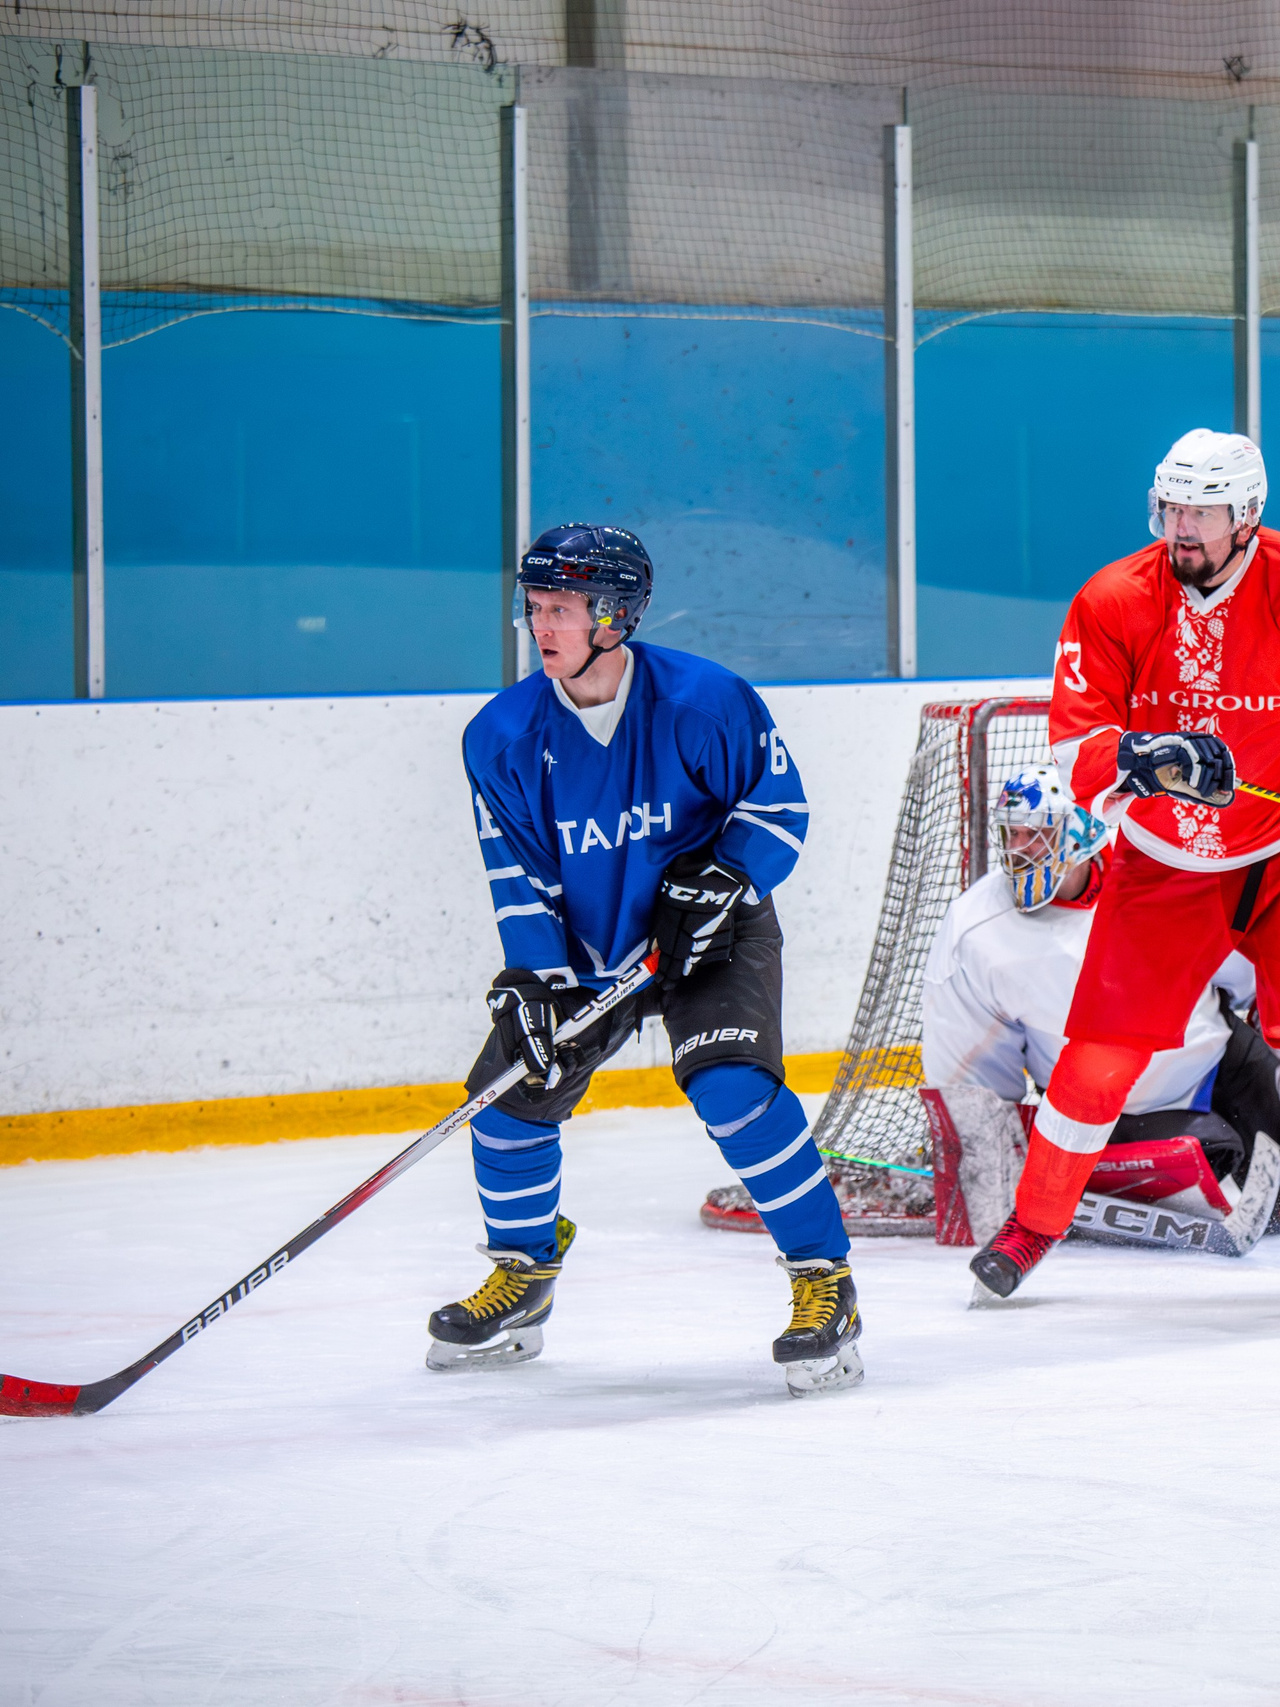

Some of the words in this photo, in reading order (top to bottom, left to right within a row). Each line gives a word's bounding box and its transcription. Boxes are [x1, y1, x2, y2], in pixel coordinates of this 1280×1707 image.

[1168, 476, 1193, 485] CCM
[527, 556, 553, 566] CCM
[619, 573, 638, 581] CCM
[759, 727, 788, 776] 6
[605, 981, 636, 1010] BAUER
[674, 1027, 759, 1066] BAUER
[181, 1250, 290, 1344] BAUER
